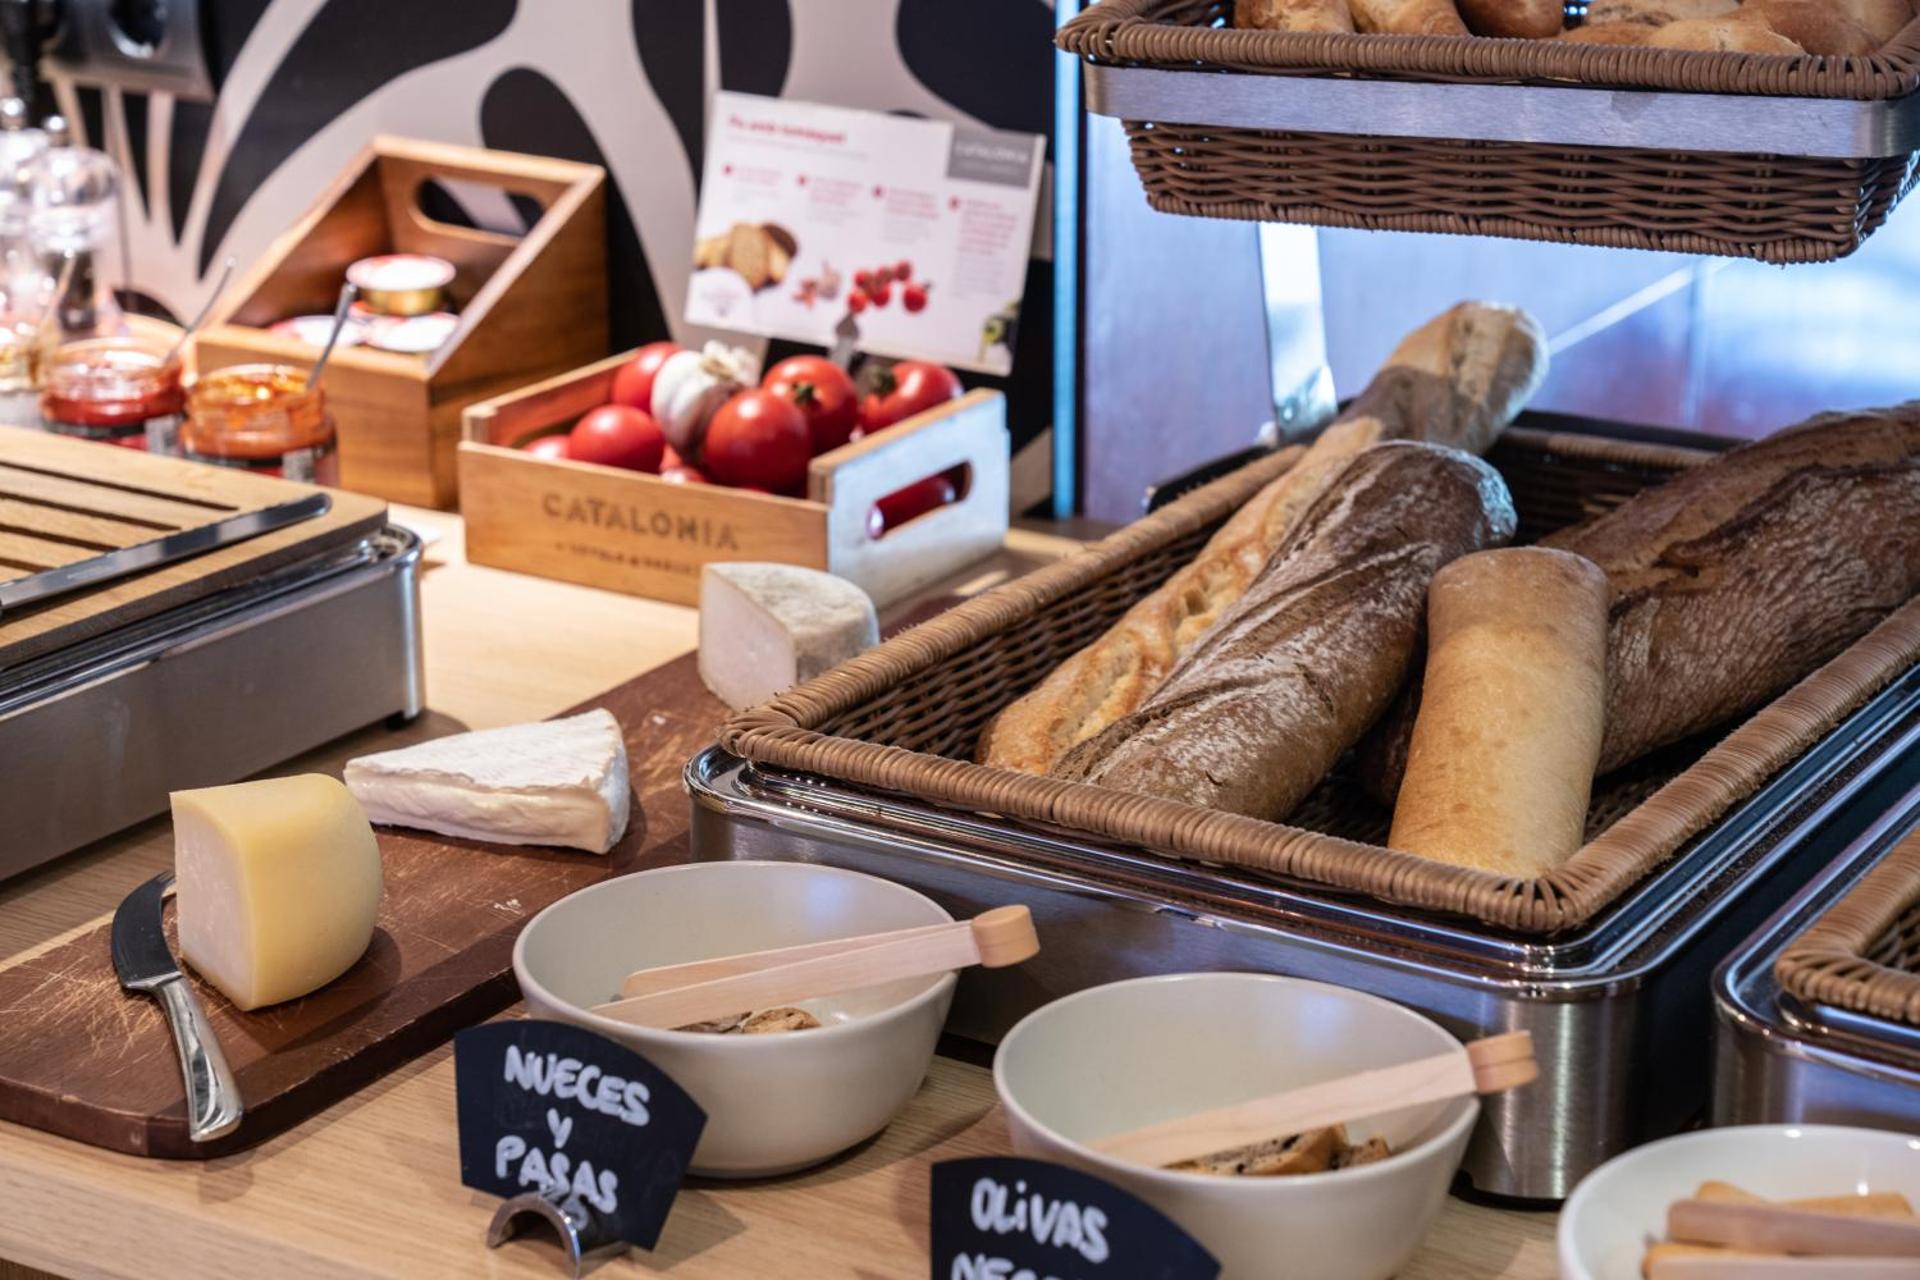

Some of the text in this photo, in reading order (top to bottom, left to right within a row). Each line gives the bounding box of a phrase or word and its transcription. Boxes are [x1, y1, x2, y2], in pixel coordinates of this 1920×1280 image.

[543, 494, 740, 551] CATALONIA
[504, 1045, 649, 1126] NUECES
[496, 1135, 618, 1213] PASAS
